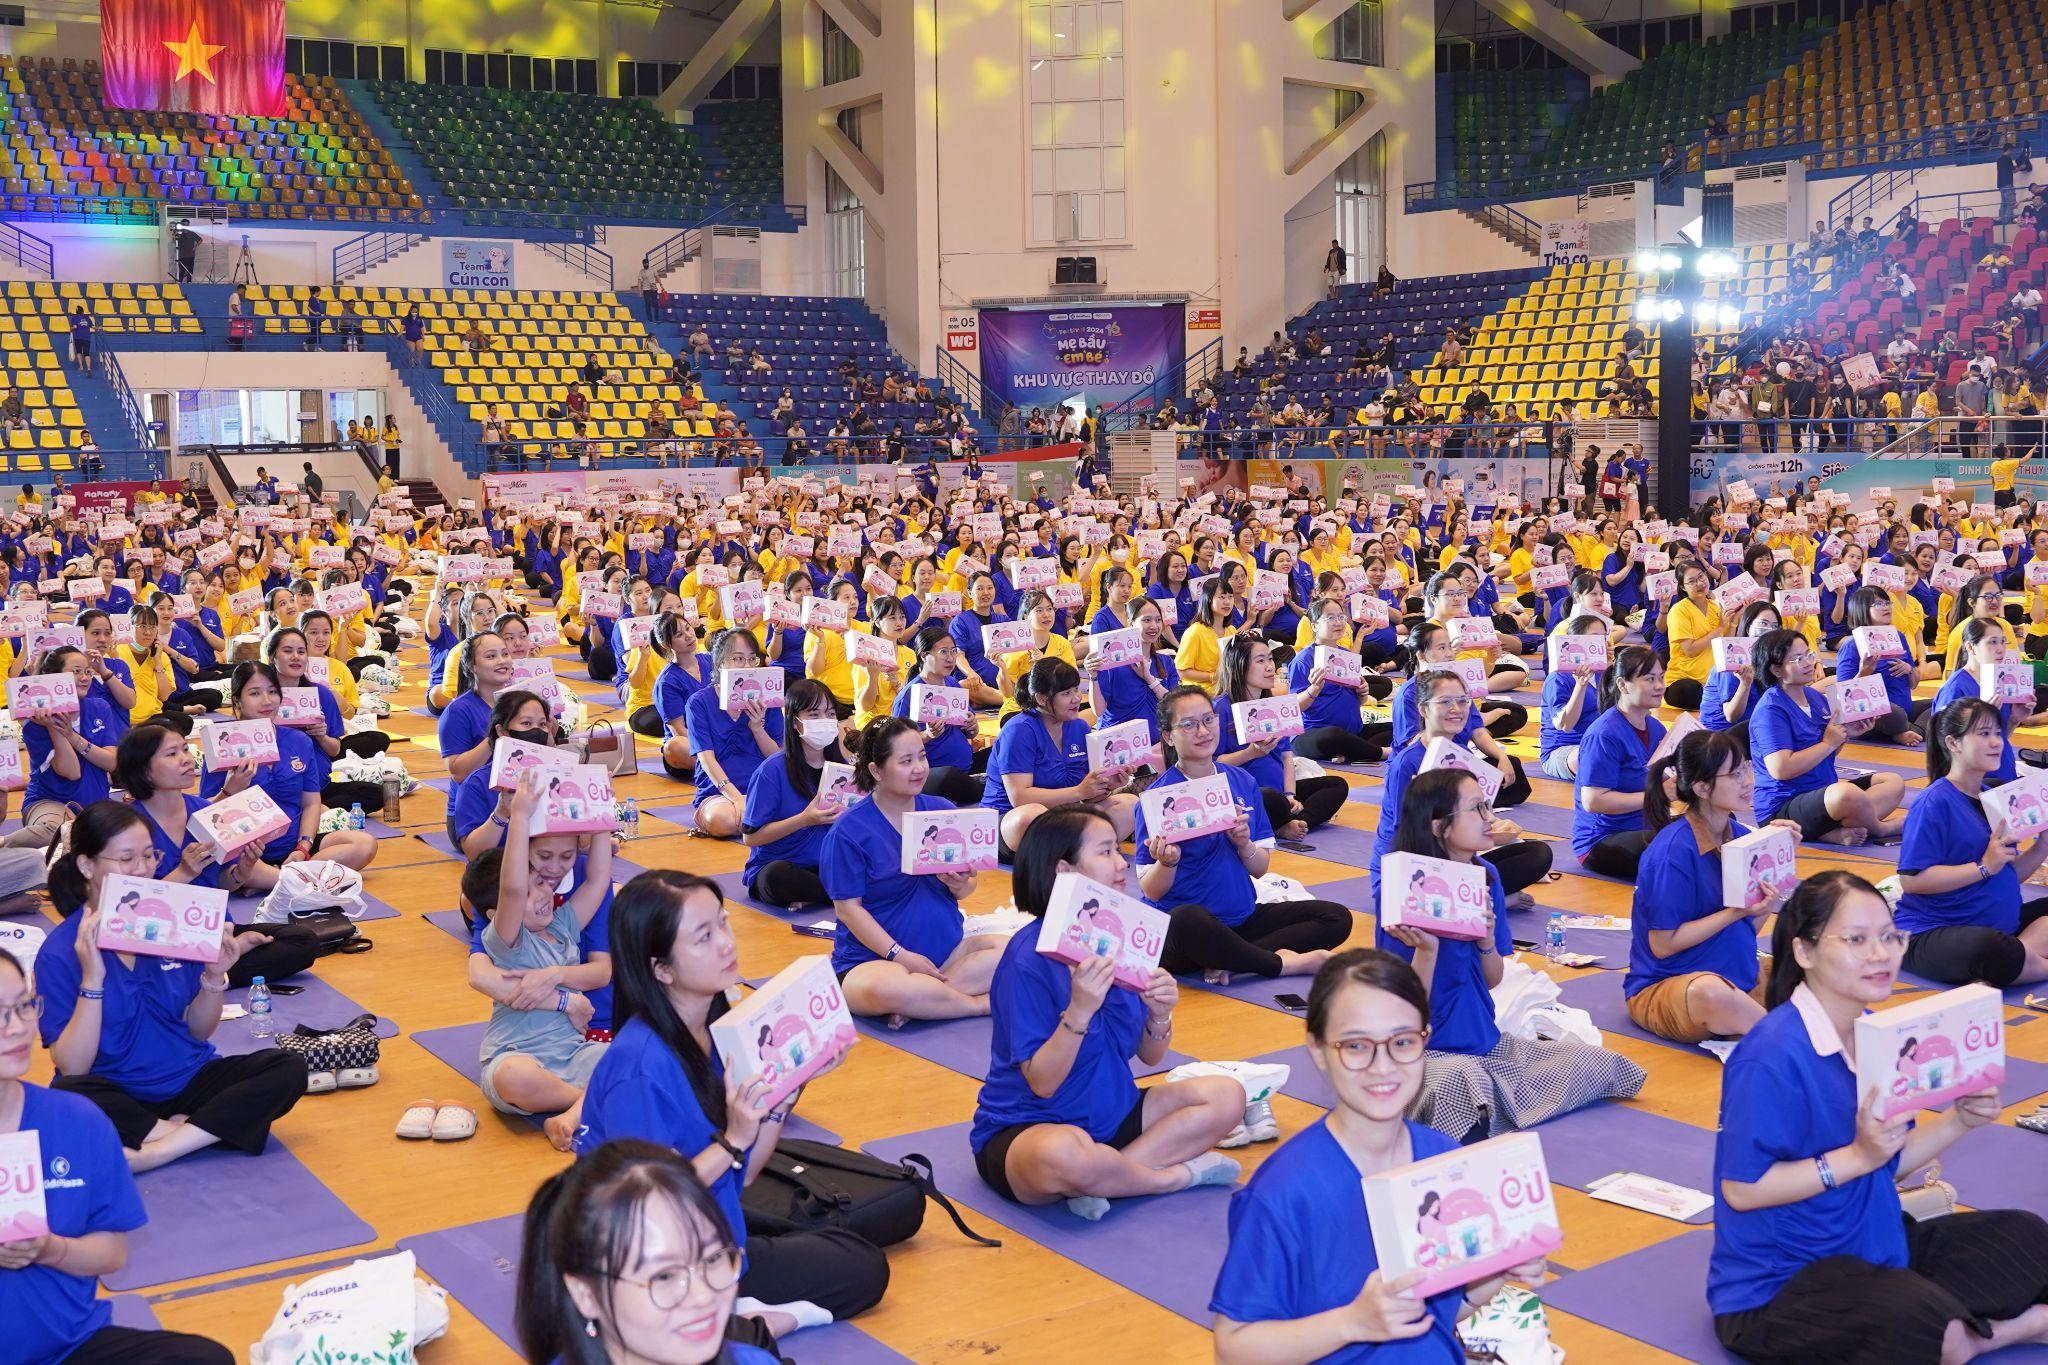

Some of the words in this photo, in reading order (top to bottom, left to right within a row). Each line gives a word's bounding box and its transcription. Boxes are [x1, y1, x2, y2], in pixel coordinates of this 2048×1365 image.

[1555, 242, 1577, 250] Team
[460, 262, 485, 270] Team
[449, 272, 479, 285] Cún
[482, 276, 509, 286] con
[961, 317, 975, 327] 05
[950, 335, 974, 347] WC
[1014, 374, 1048, 388] KHU
[1051, 371, 1084, 391] VỰC
[1086, 371, 1128, 386] THAY
[1780, 458, 1802, 473] 12h
[1958, 465, 1981, 475] DINH
